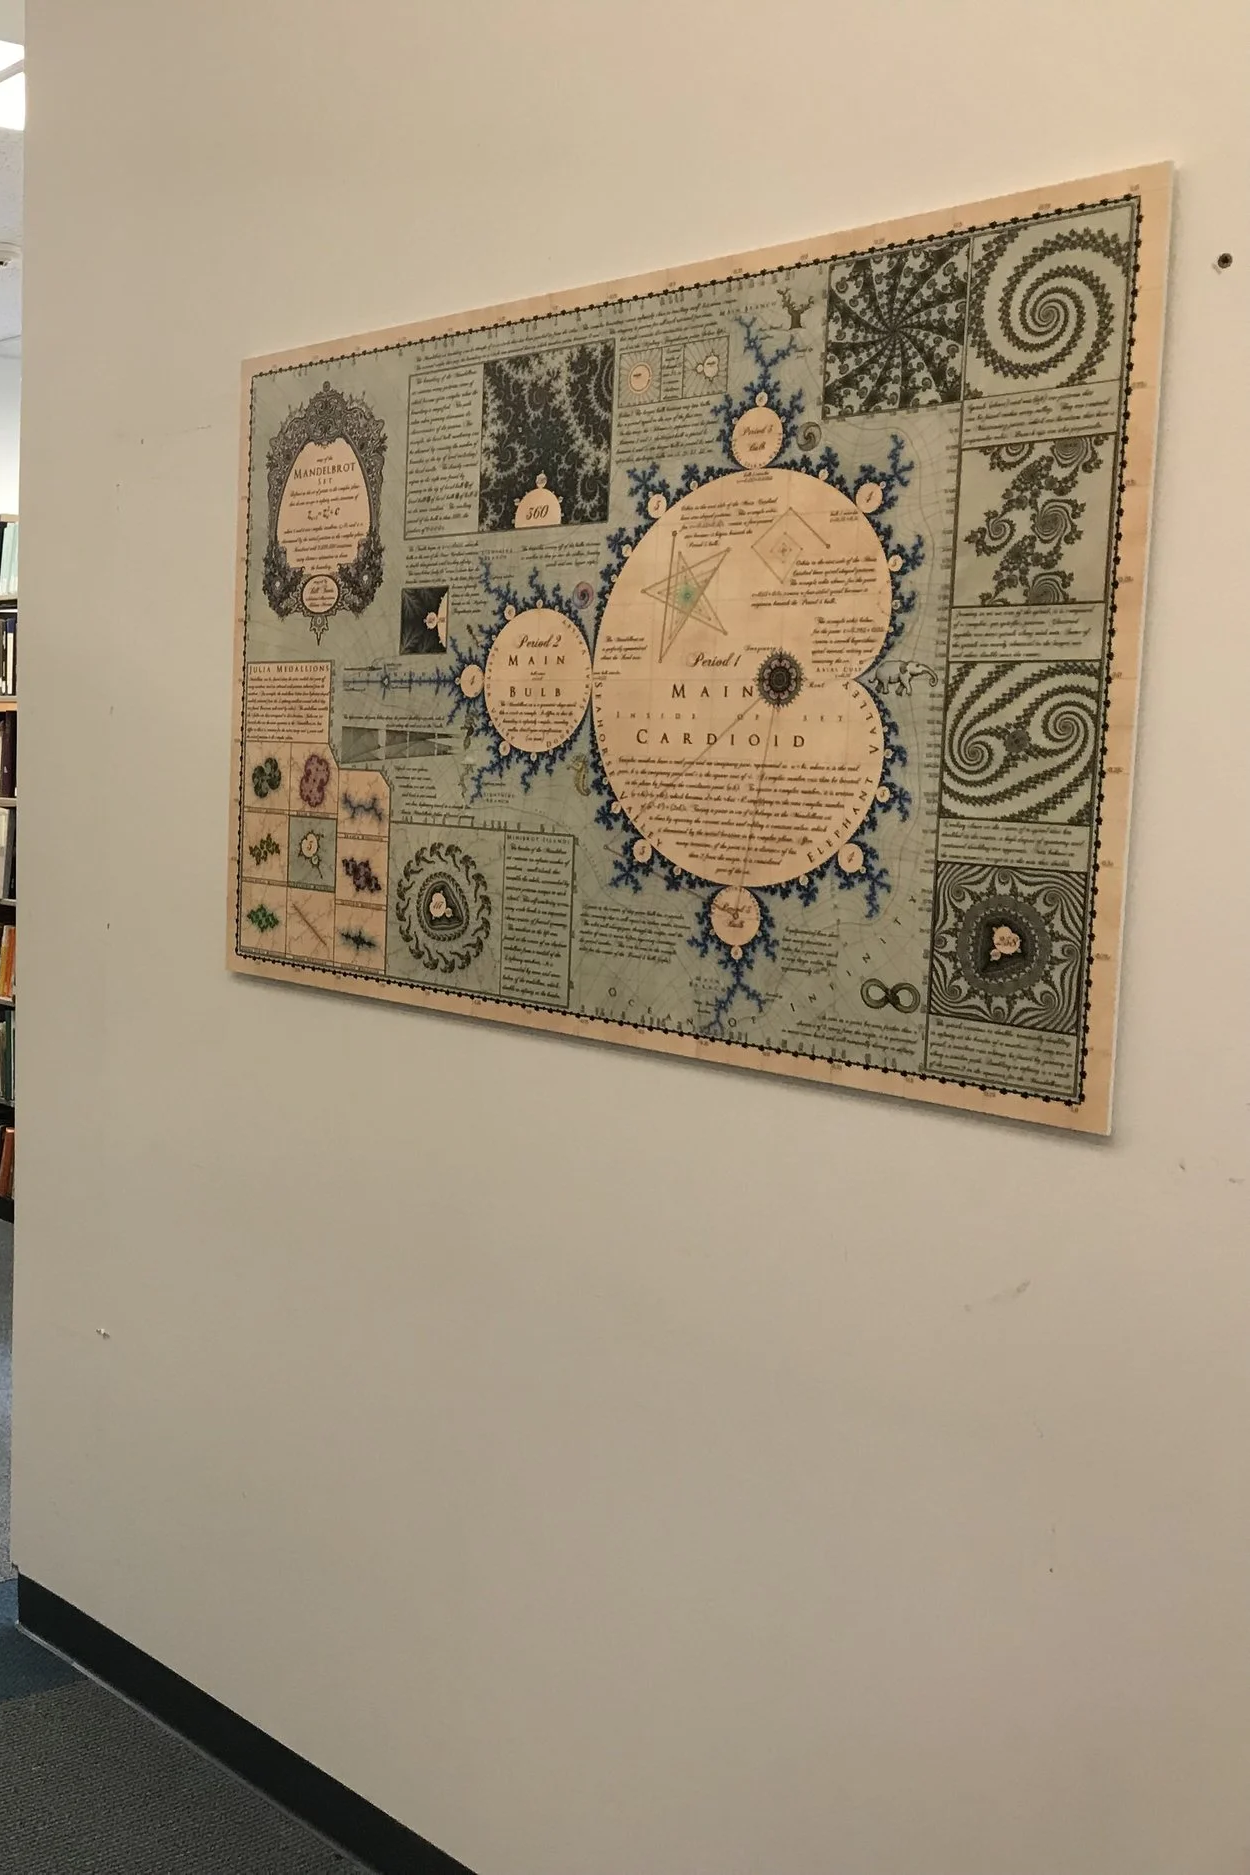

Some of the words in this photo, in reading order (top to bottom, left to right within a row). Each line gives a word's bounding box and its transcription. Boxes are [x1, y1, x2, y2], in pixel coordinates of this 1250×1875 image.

[294, 462, 356, 480] MANDELBROT
[526, 504, 549, 521] 360
[517, 634, 553, 649] Period
[553, 635, 562, 648] 2
[508, 655, 565, 667] MAIN
[689, 652, 734, 668] Period
[249, 665, 270, 675] JULIA
[276, 664, 329, 673] MEDALLIONS
[509, 686, 562, 698] BULB
[671, 684, 754, 698] MAIN
[636, 729, 805, 748] CARDIOID
[790, 895, 917, 1012] INFINITY
